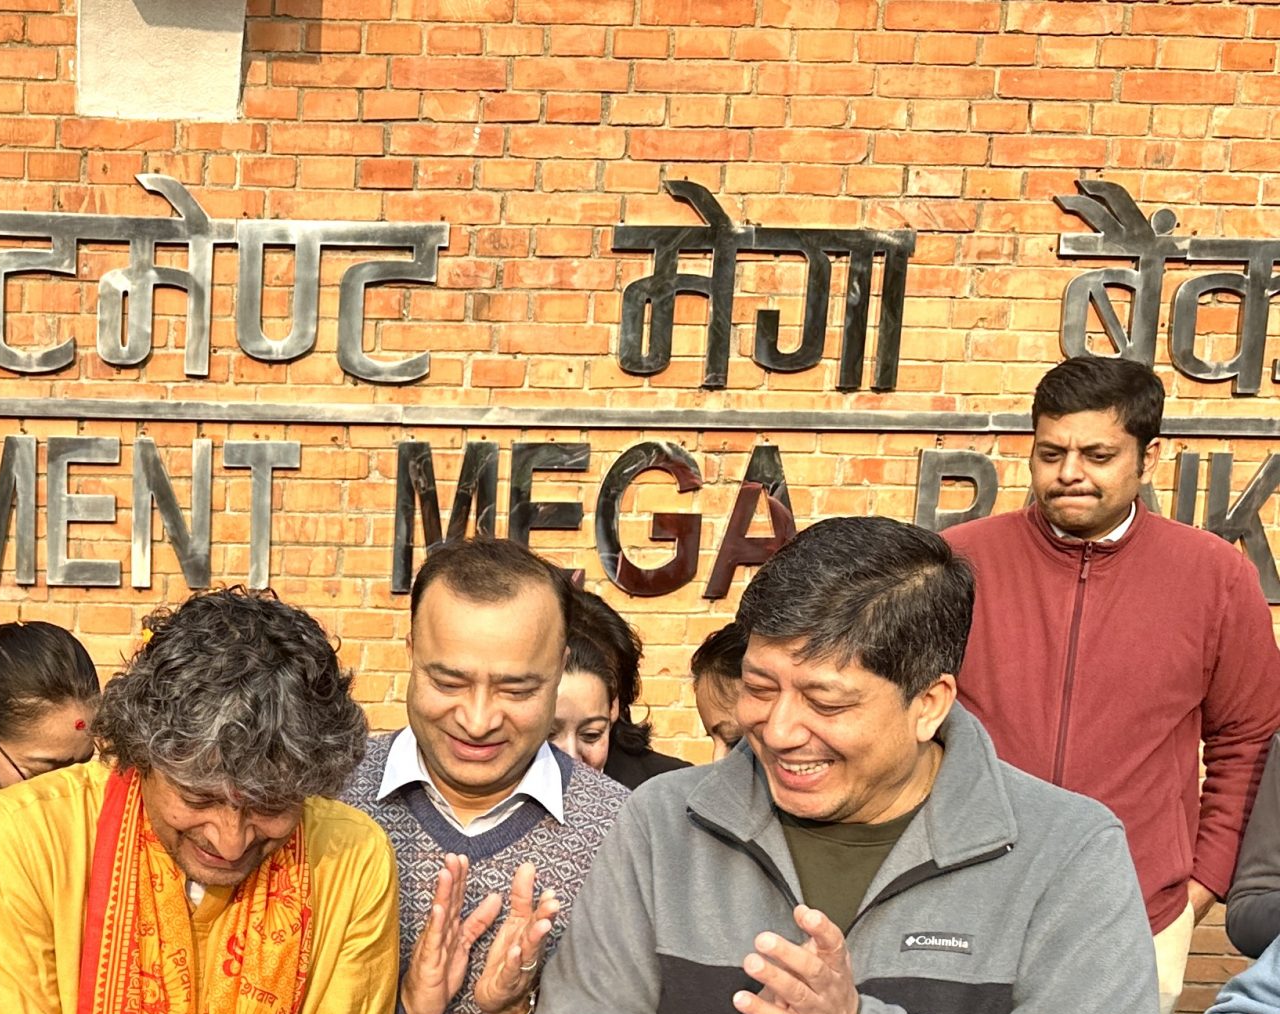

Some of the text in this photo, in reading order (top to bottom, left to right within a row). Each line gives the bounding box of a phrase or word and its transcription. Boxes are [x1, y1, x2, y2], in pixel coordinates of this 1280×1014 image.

[612, 179, 914, 390] मेगा
[391, 441, 797, 599] MEGA
[915, 935, 969, 949] Columbia
